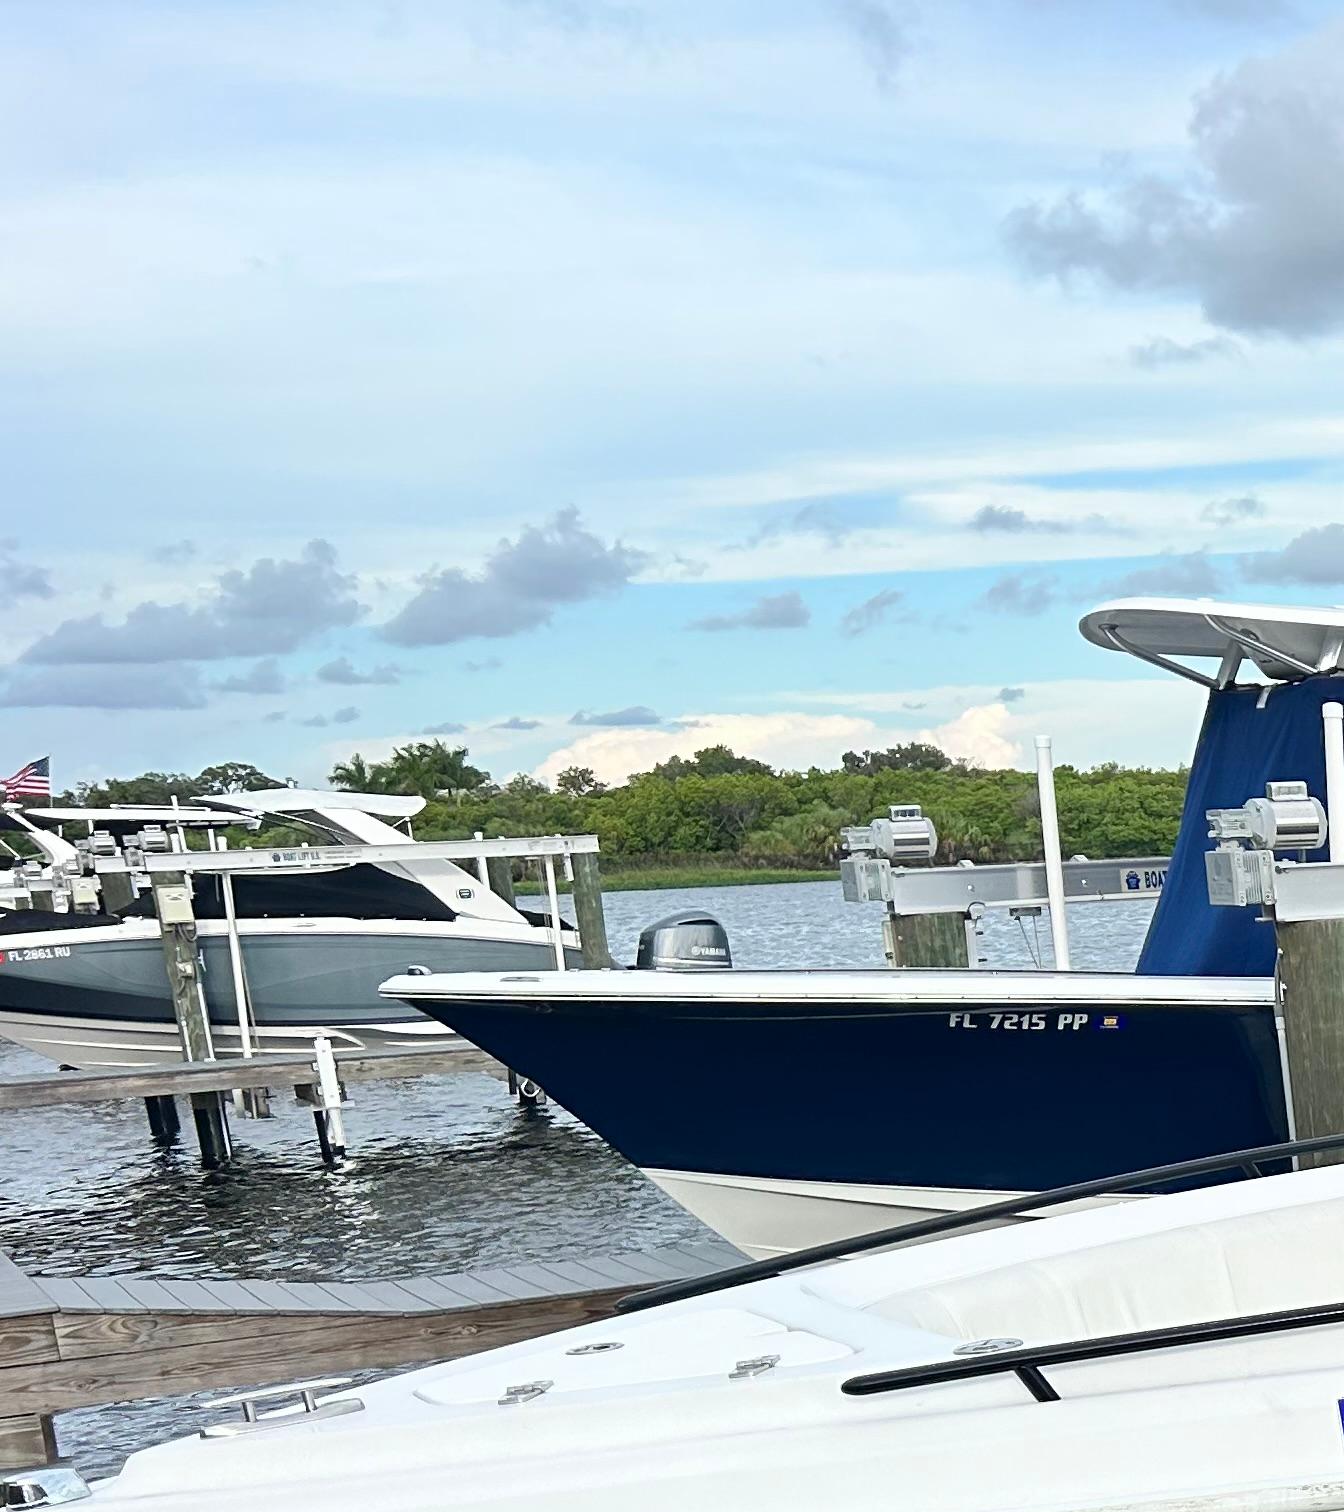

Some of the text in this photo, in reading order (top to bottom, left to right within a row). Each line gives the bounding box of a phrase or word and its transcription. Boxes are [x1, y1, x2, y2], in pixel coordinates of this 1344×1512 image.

[8, 951, 23, 961] FL
[54, 946, 71, 957] RU
[949, 1013, 977, 1028] FL
[989, 1013, 1047, 1030] 7215
[1057, 1013, 1088, 1030] PP
